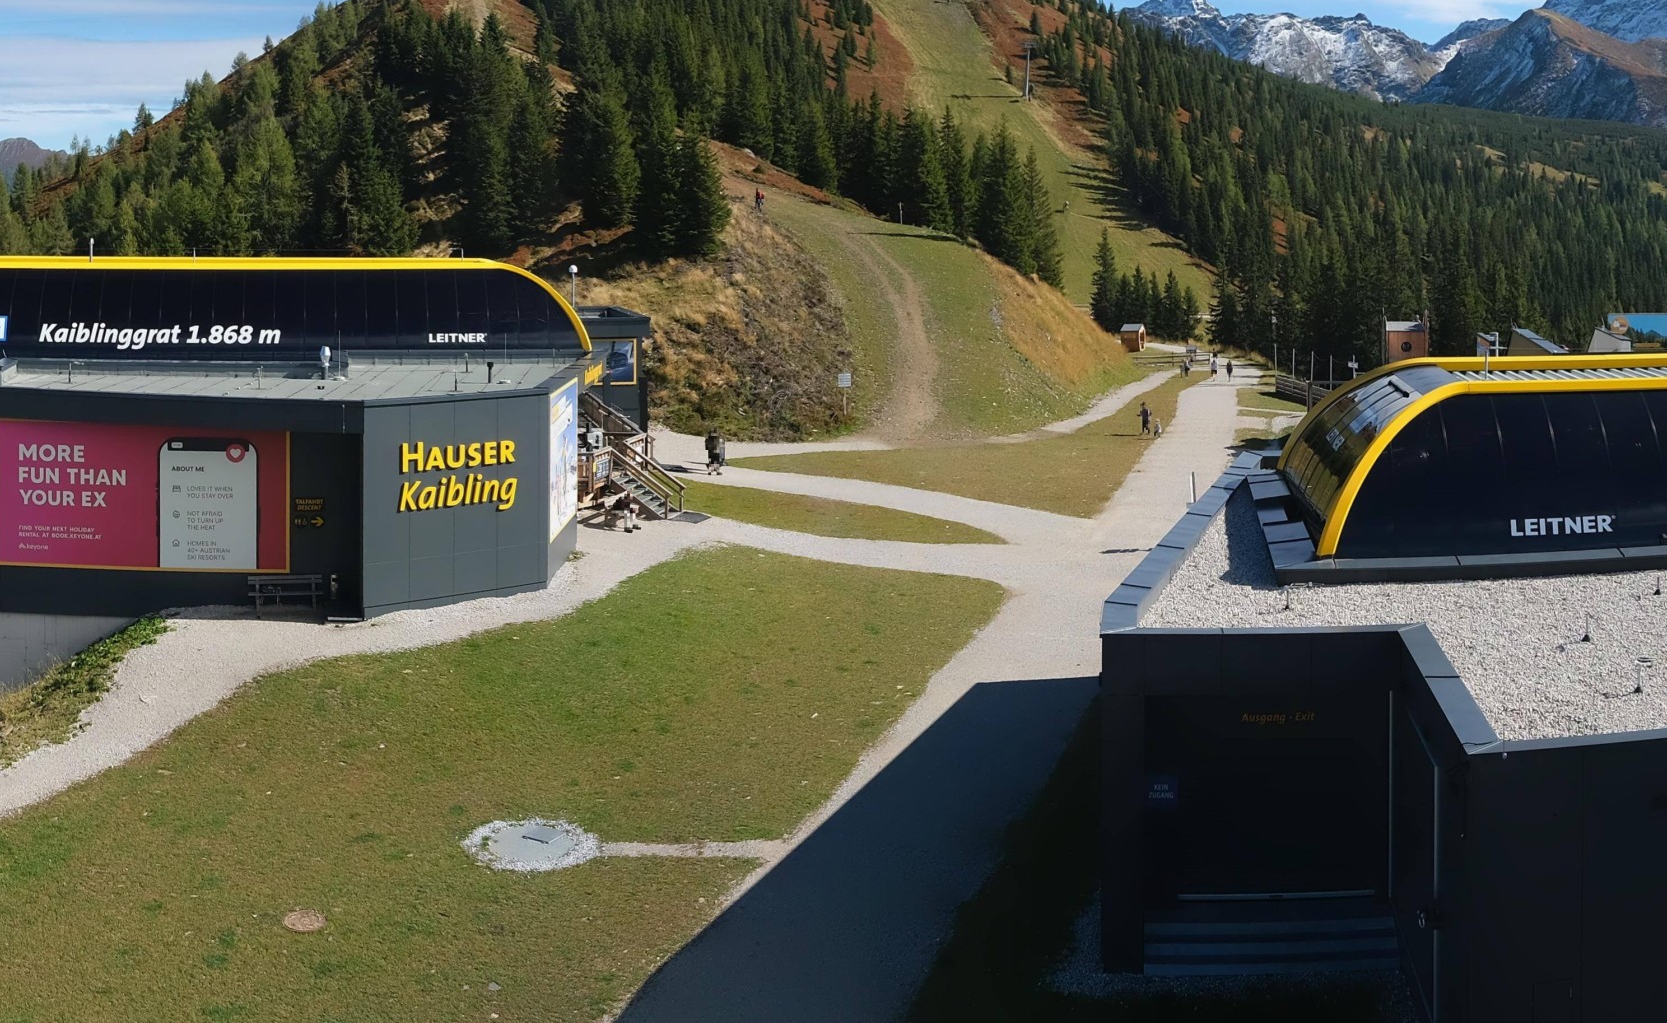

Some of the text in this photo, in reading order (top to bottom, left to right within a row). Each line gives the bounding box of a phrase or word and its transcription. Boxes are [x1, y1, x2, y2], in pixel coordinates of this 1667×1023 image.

[38, 322, 281, 350] Kaiblinggrat 1.868 m
[428, 332, 486, 343] LEITNER
[18, 443, 85, 463] MORE
[400, 439, 516, 474] HAUSER
[18, 466, 127, 486] FUN THAN
[19, 489, 106, 507] YOUR EX
[398, 473, 518, 513] Kaibling
[1510, 514, 1614, 537] LEITNER
[26, 543, 49, 551] keyone
[1240, 711, 1316, 725] Ausgang Exit
